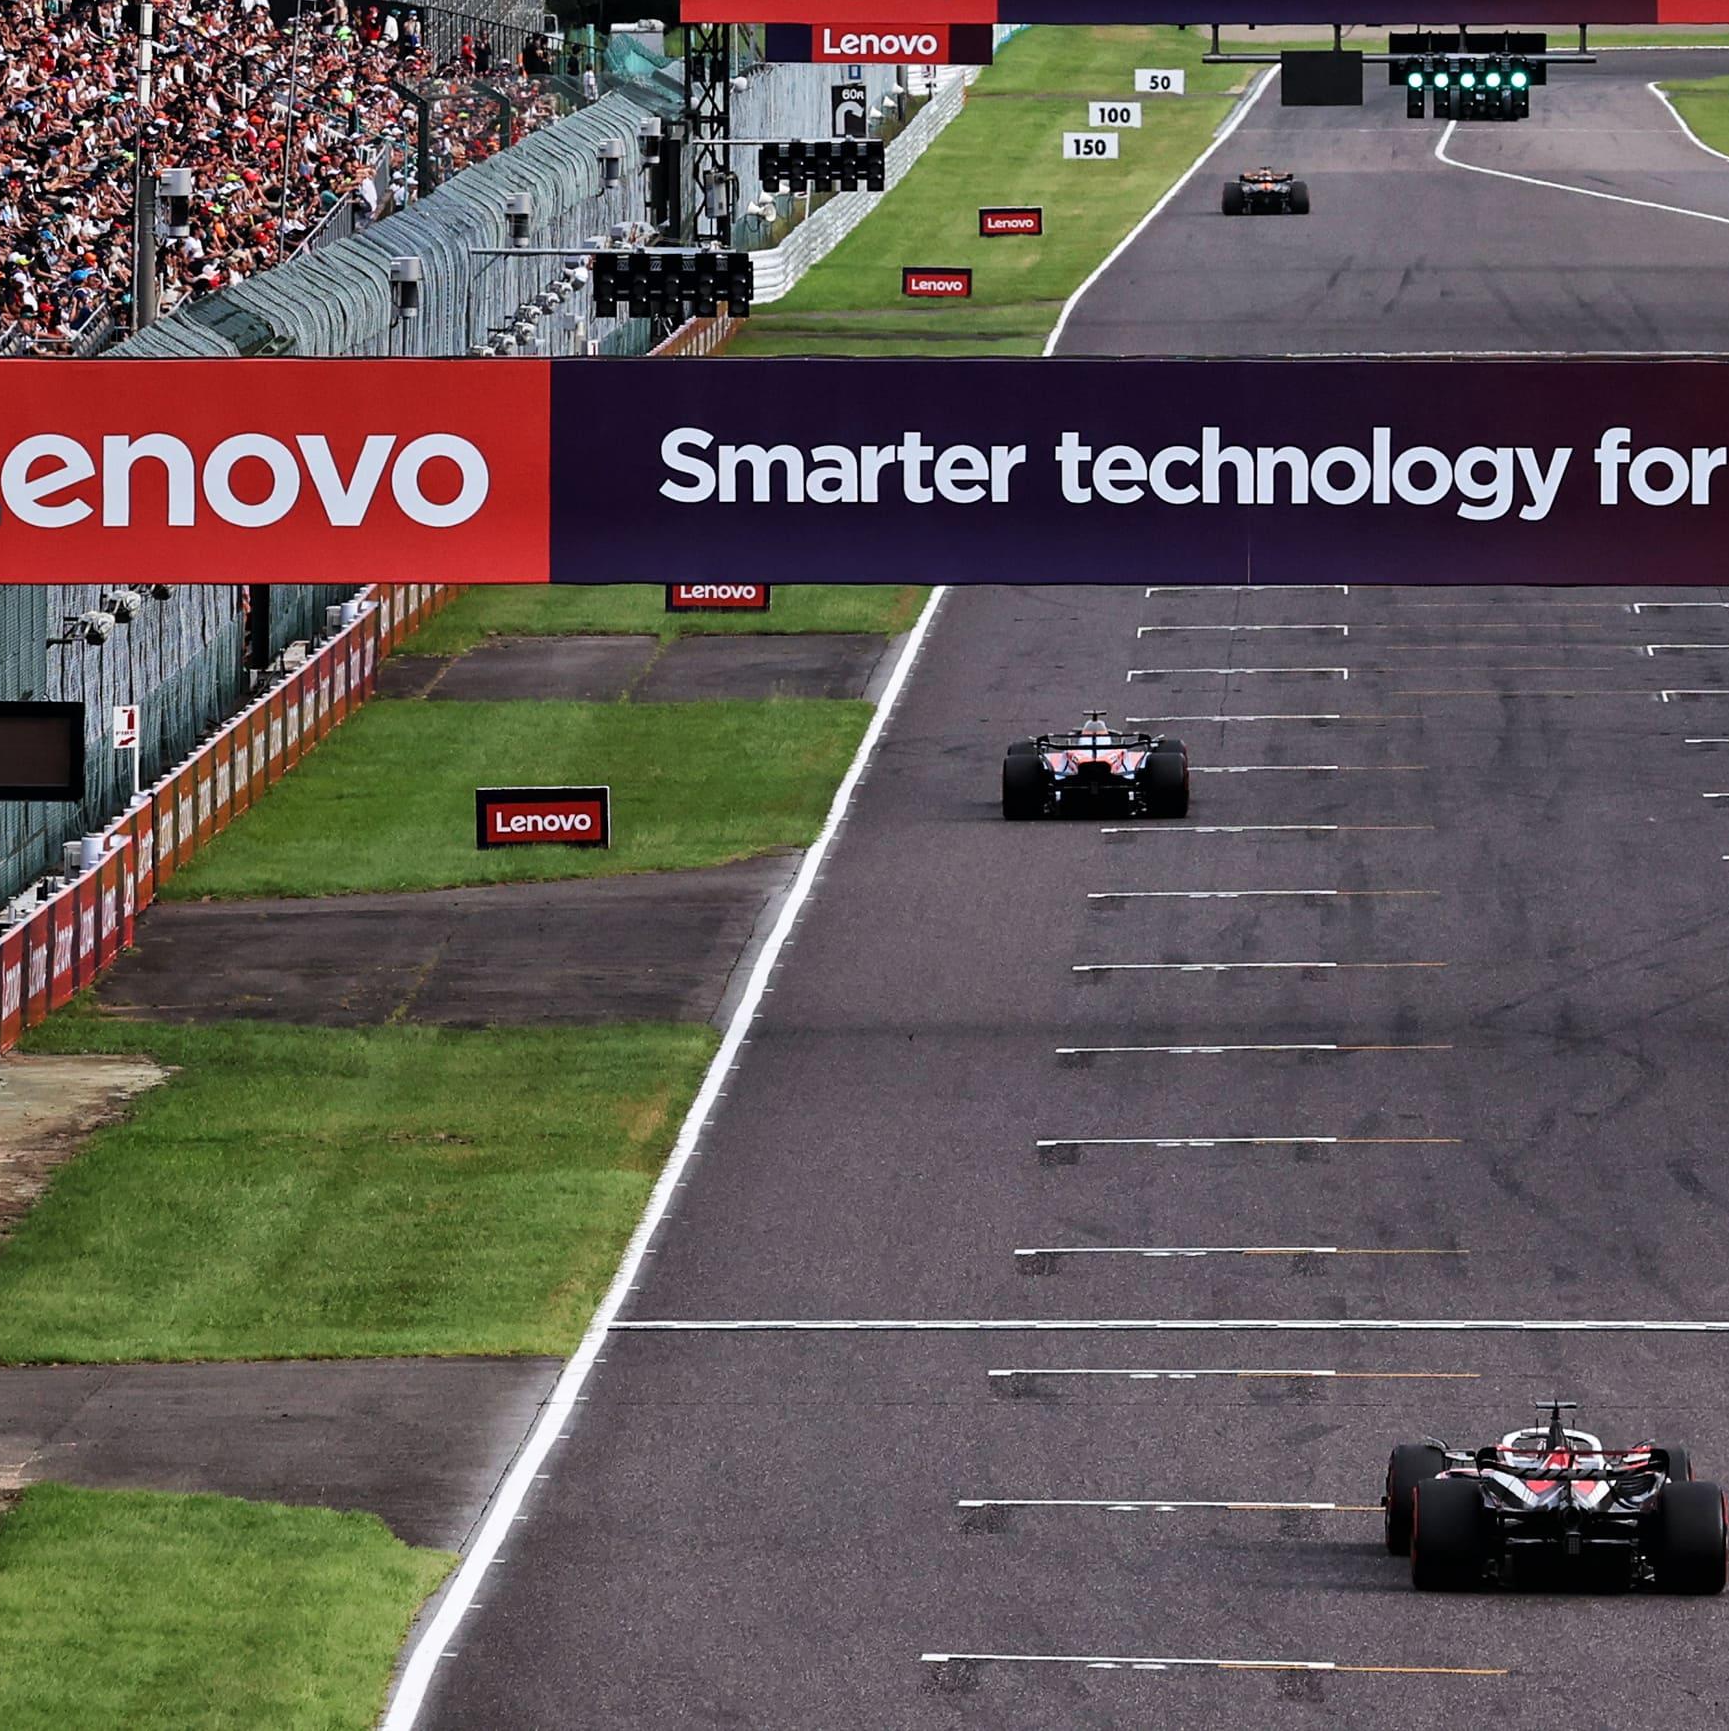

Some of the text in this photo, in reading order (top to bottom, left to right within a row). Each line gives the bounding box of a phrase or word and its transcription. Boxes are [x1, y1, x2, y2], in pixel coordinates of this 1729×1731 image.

[823, 28, 937, 55] Lenovo
[1149, 76, 1171, 90] 50
[842, 88, 864, 100] 60R
[1098, 107, 1131, 123] 100
[1073, 139, 1106, 156] 150
[987, 218, 1034, 229] Lenovo
[911, 278, 963, 291] Lenovo
[659, 427, 1026, 503] Smarter
[1056, 427, 1572, 520] technology
[1594, 427, 1727, 505] for
[680, 585, 756, 601] Lenovo
[496, 811, 592, 833] Lenovo
